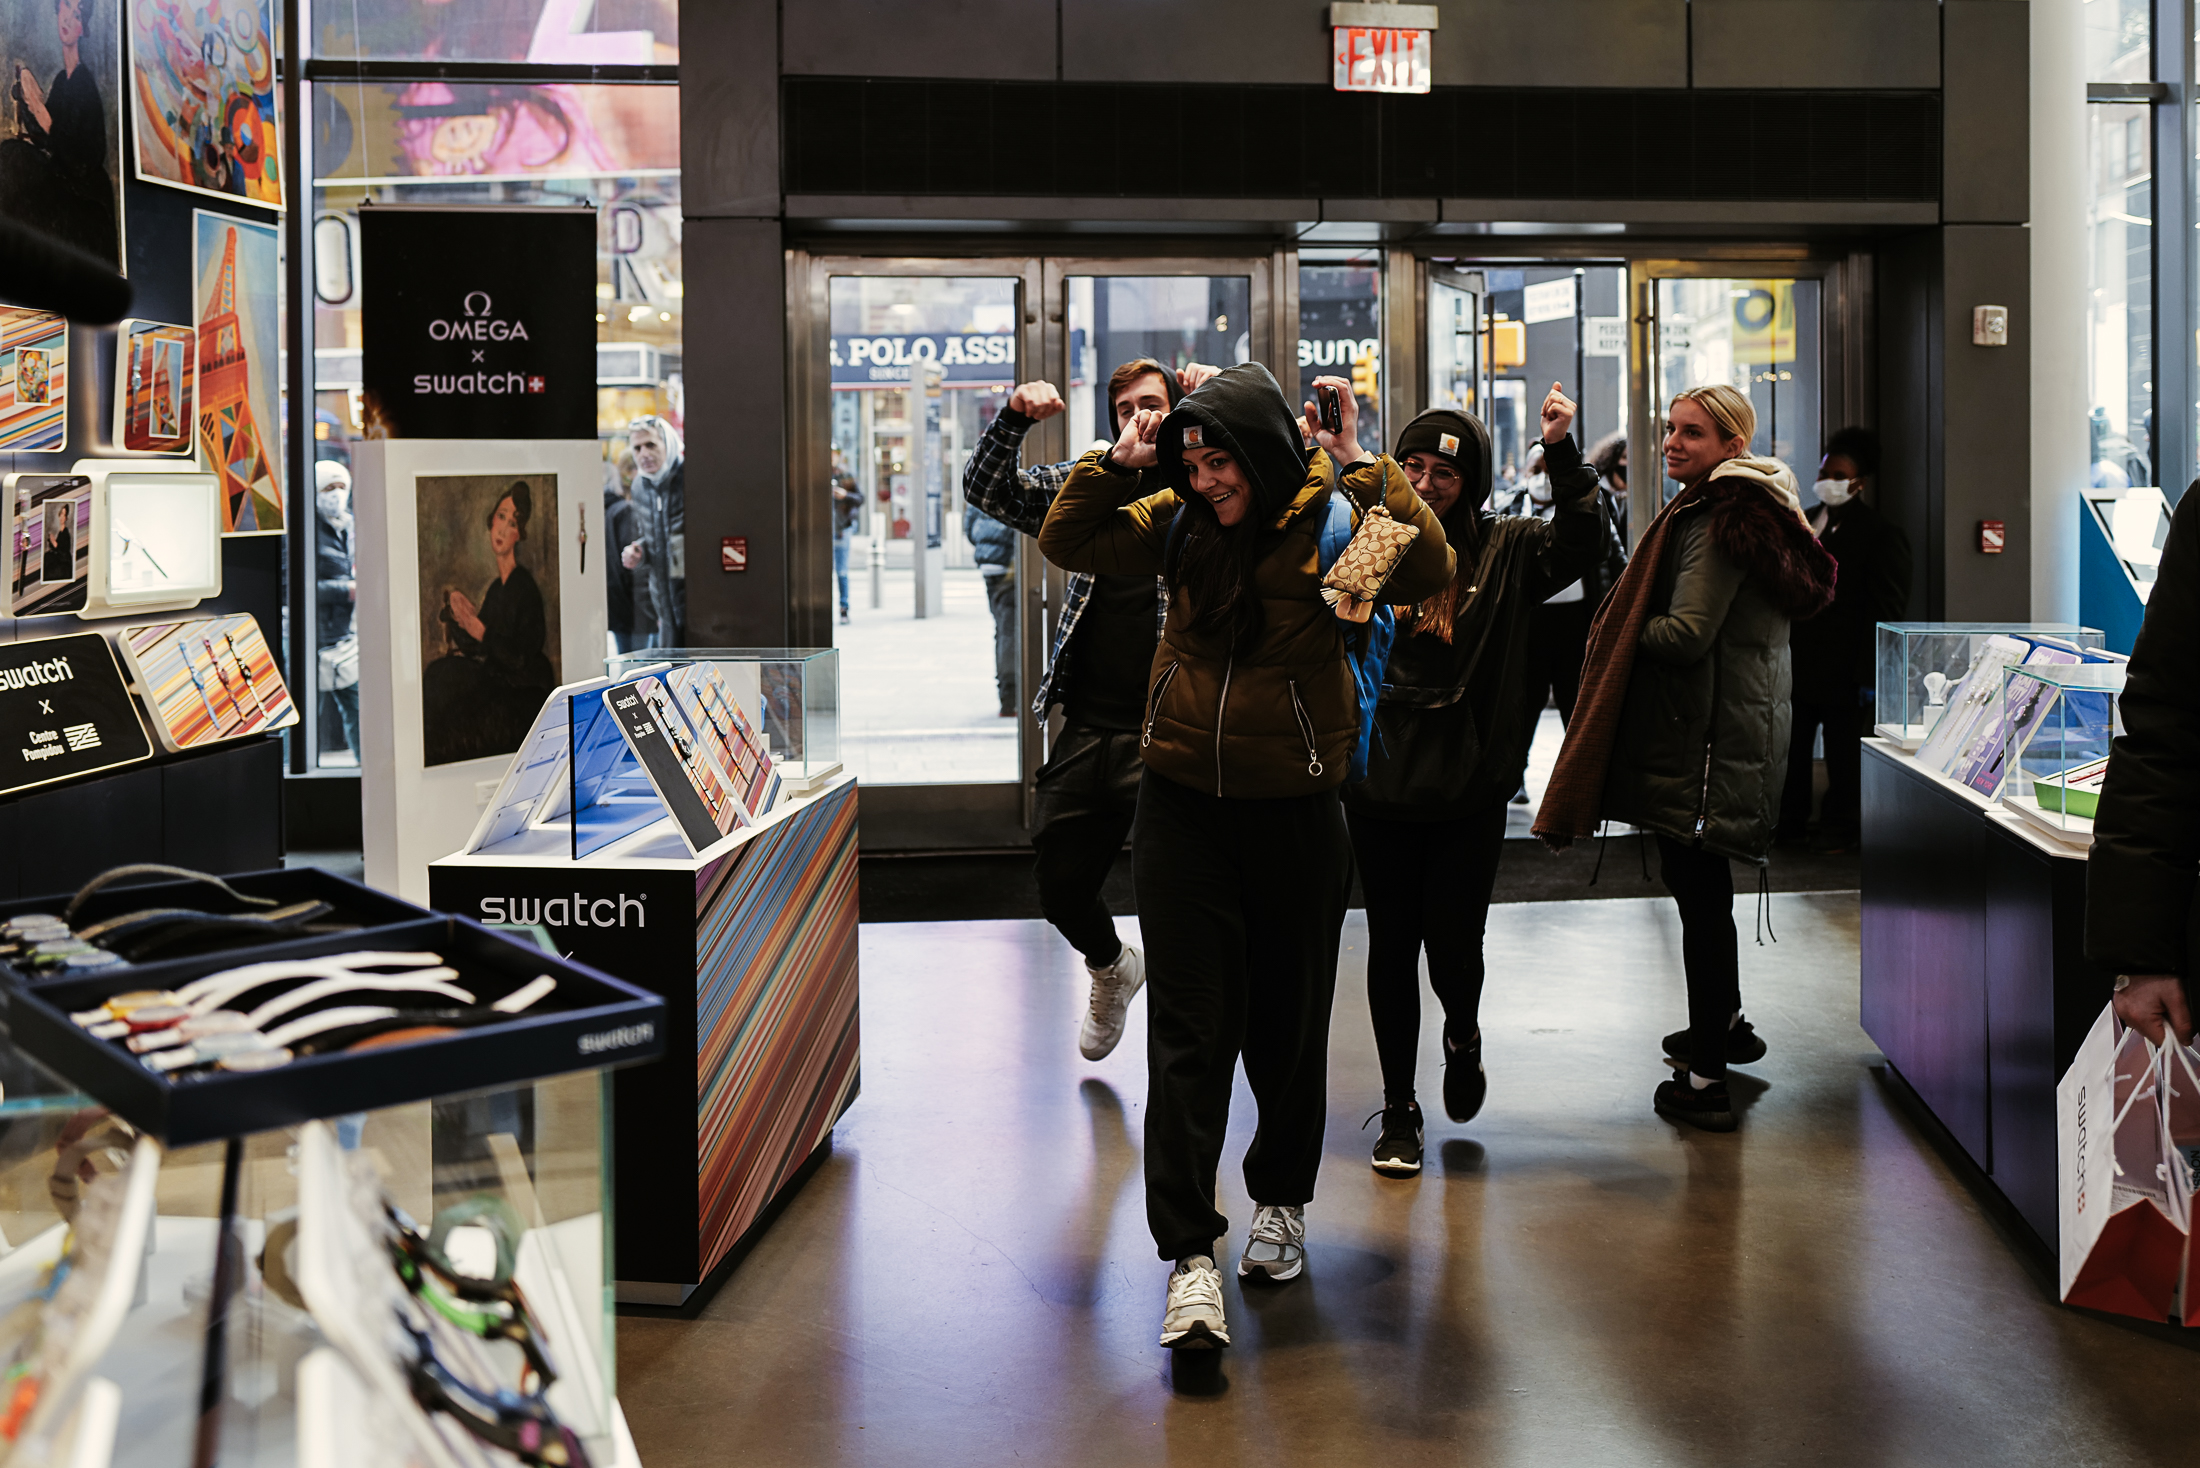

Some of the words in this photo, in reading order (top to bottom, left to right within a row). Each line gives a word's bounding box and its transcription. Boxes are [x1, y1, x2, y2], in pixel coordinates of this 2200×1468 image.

[1347, 29, 1419, 86] EXIT
[428, 319, 529, 341] OMEGA
[848, 337, 938, 366] POLO
[413, 371, 525, 394] swatch
[29, 730, 59, 744] Centre
[21, 744, 65, 762] Pompidou
[2076, 1085, 2088, 1194] swatch
